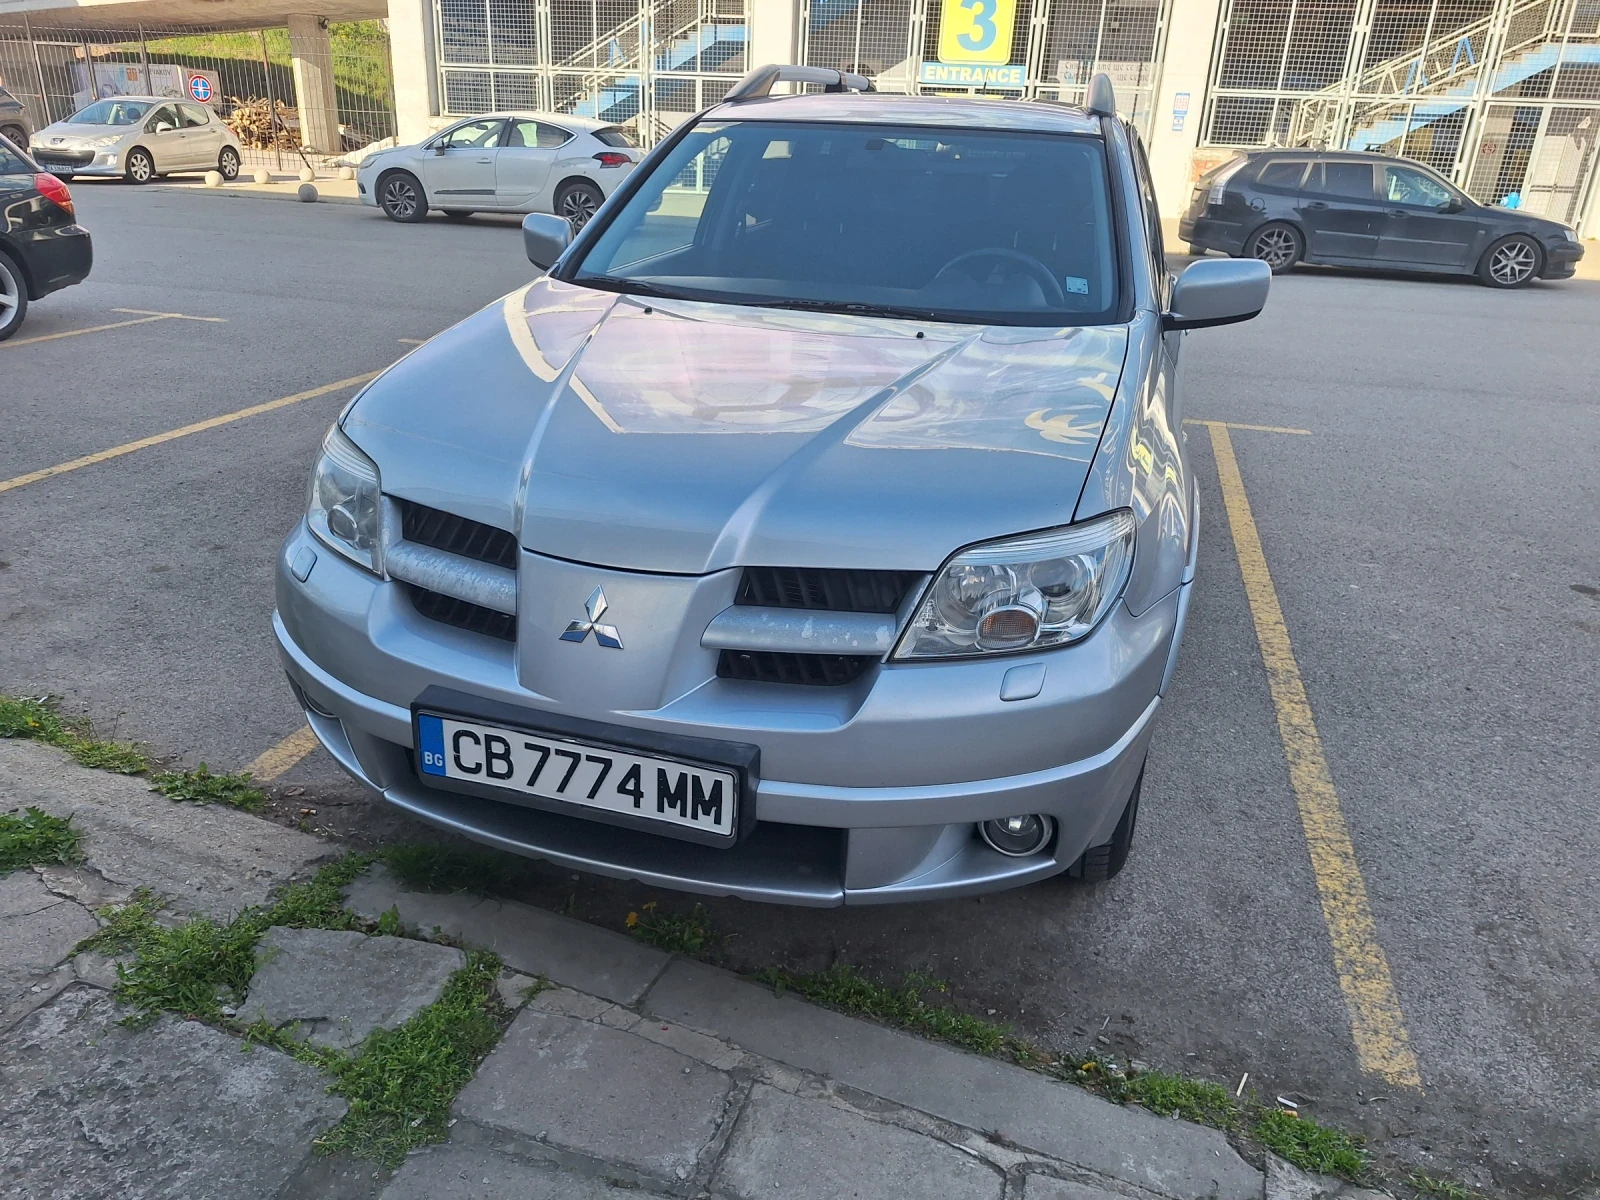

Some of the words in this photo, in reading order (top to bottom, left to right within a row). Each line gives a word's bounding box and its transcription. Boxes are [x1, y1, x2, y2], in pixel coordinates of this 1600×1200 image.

[957, 0, 997, 51] 3
[924, 65, 1021, 83] ENTRANCE
[424, 751, 443, 767] BG
[452, 729, 514, 780] CB
[524, 742, 644, 808] 7774
[657, 767, 723, 825] MM
